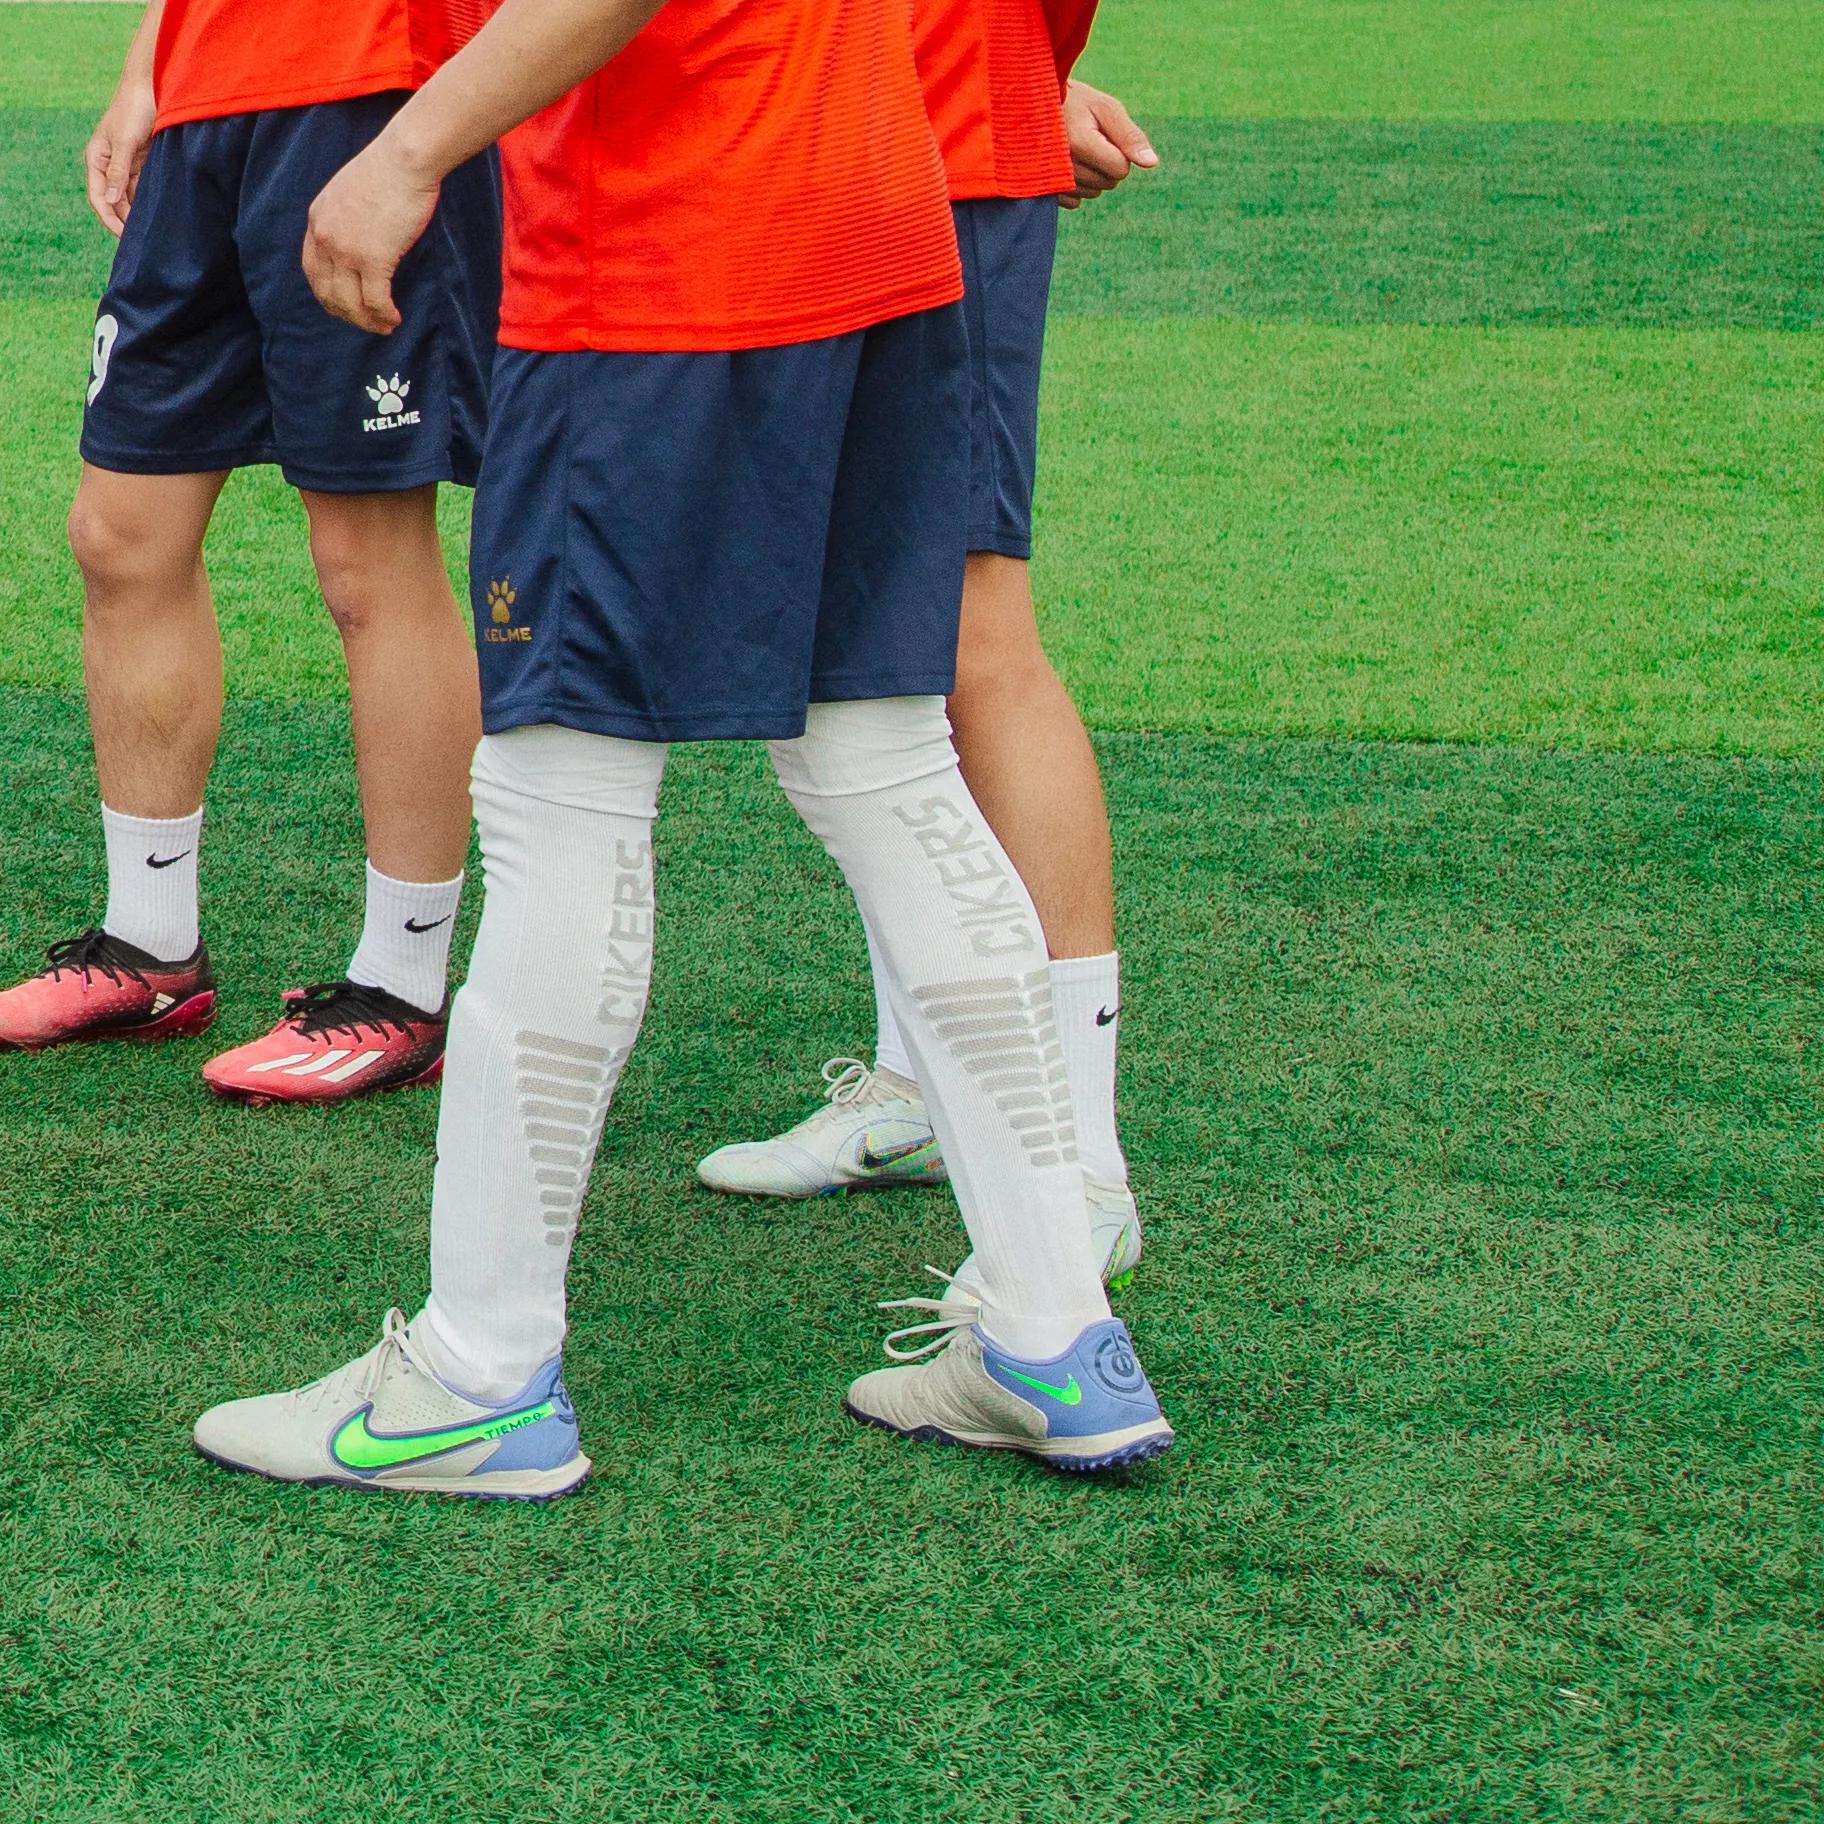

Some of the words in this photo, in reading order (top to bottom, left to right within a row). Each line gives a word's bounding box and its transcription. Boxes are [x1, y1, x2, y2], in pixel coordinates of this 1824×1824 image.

[362, 410, 422, 432] KELME
[483, 626, 533, 644] KELME
[891, 795, 1036, 958] CIKERS
[483, 1412, 542, 1439] TIEMPO
